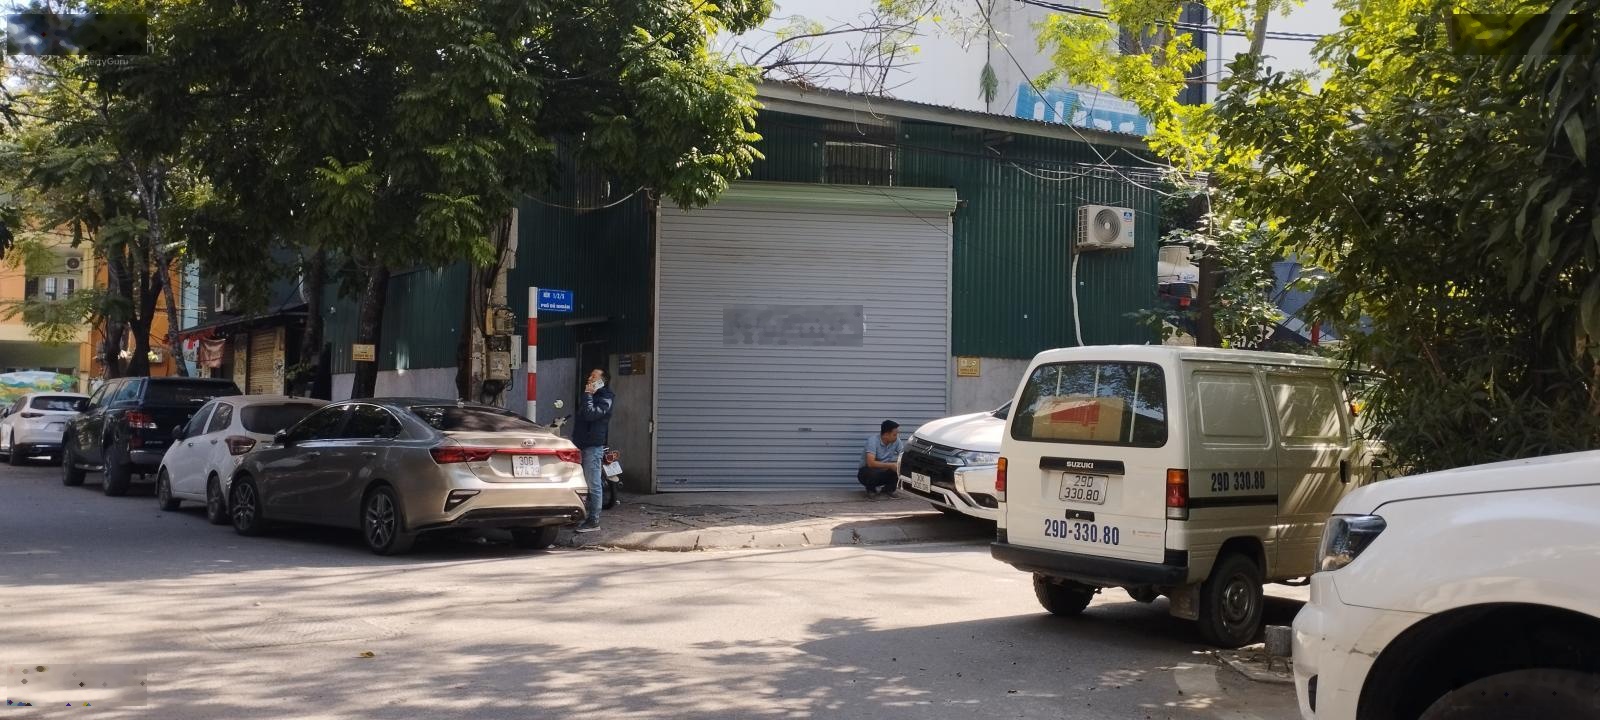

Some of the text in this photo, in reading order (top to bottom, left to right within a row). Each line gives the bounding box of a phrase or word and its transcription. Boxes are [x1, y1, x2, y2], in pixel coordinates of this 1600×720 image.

[519, 457, 533, 465] 30G
[1066, 461, 1094, 469] SUZUKI
[1074, 475, 1094, 488] 29D
[1211, 471, 1265, 491] 29D 330.80
[1064, 487, 1100, 501] 330.80
[1045, 519, 1119, 545] 29D-330.80
